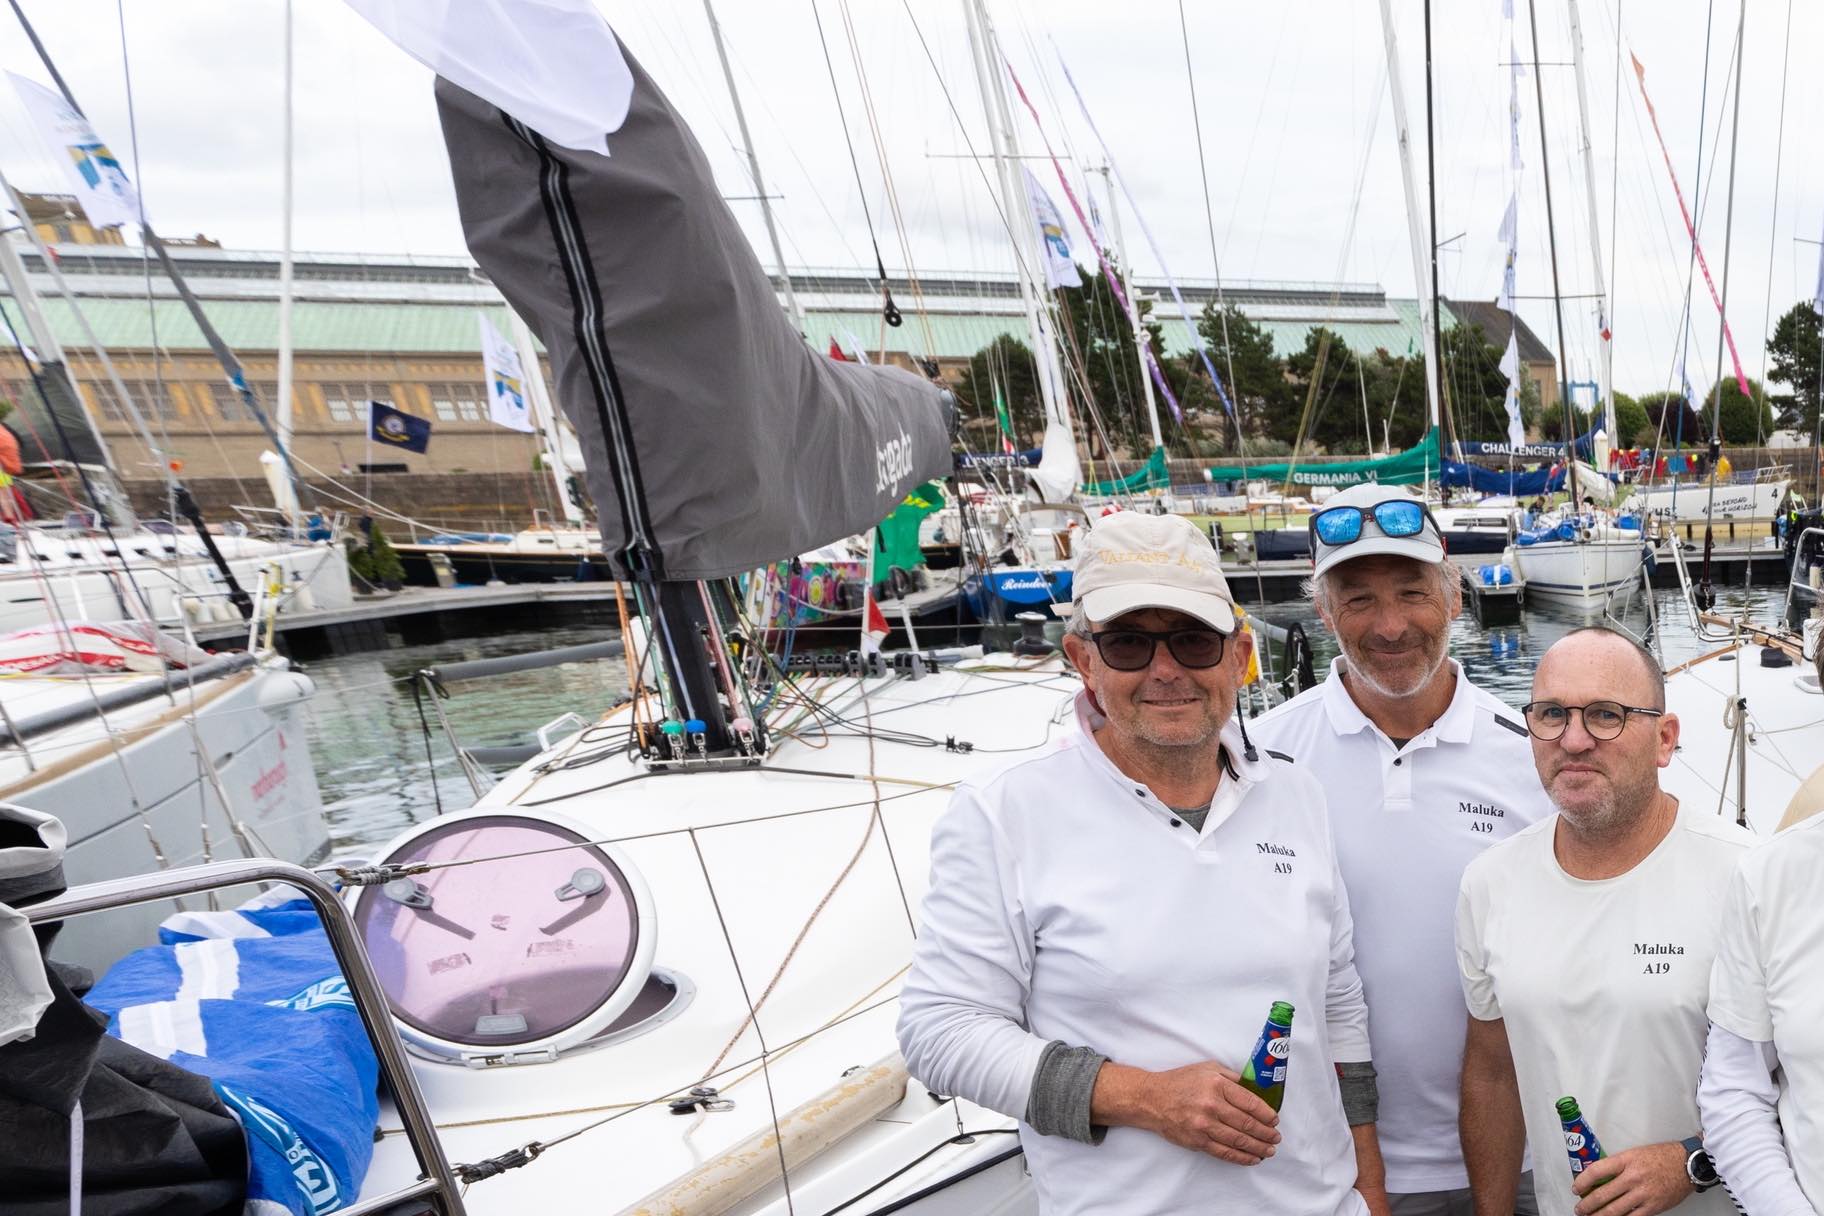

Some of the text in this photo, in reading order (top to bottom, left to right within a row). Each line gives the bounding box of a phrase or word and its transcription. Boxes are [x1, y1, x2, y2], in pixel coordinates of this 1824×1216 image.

[1481, 442, 1556, 457] CHALLENGER
[1294, 472, 1361, 484] GERMANIA
[1459, 802, 1504, 818] Maluka
[1470, 821, 1493, 833] A19
[1256, 842, 1296, 857] Maluka
[1274, 862, 1292, 874] A19
[1633, 943, 1685, 955] Maluka
[1643, 962, 1671, 975] A19
[1270, 1040, 1290, 1054] 166
